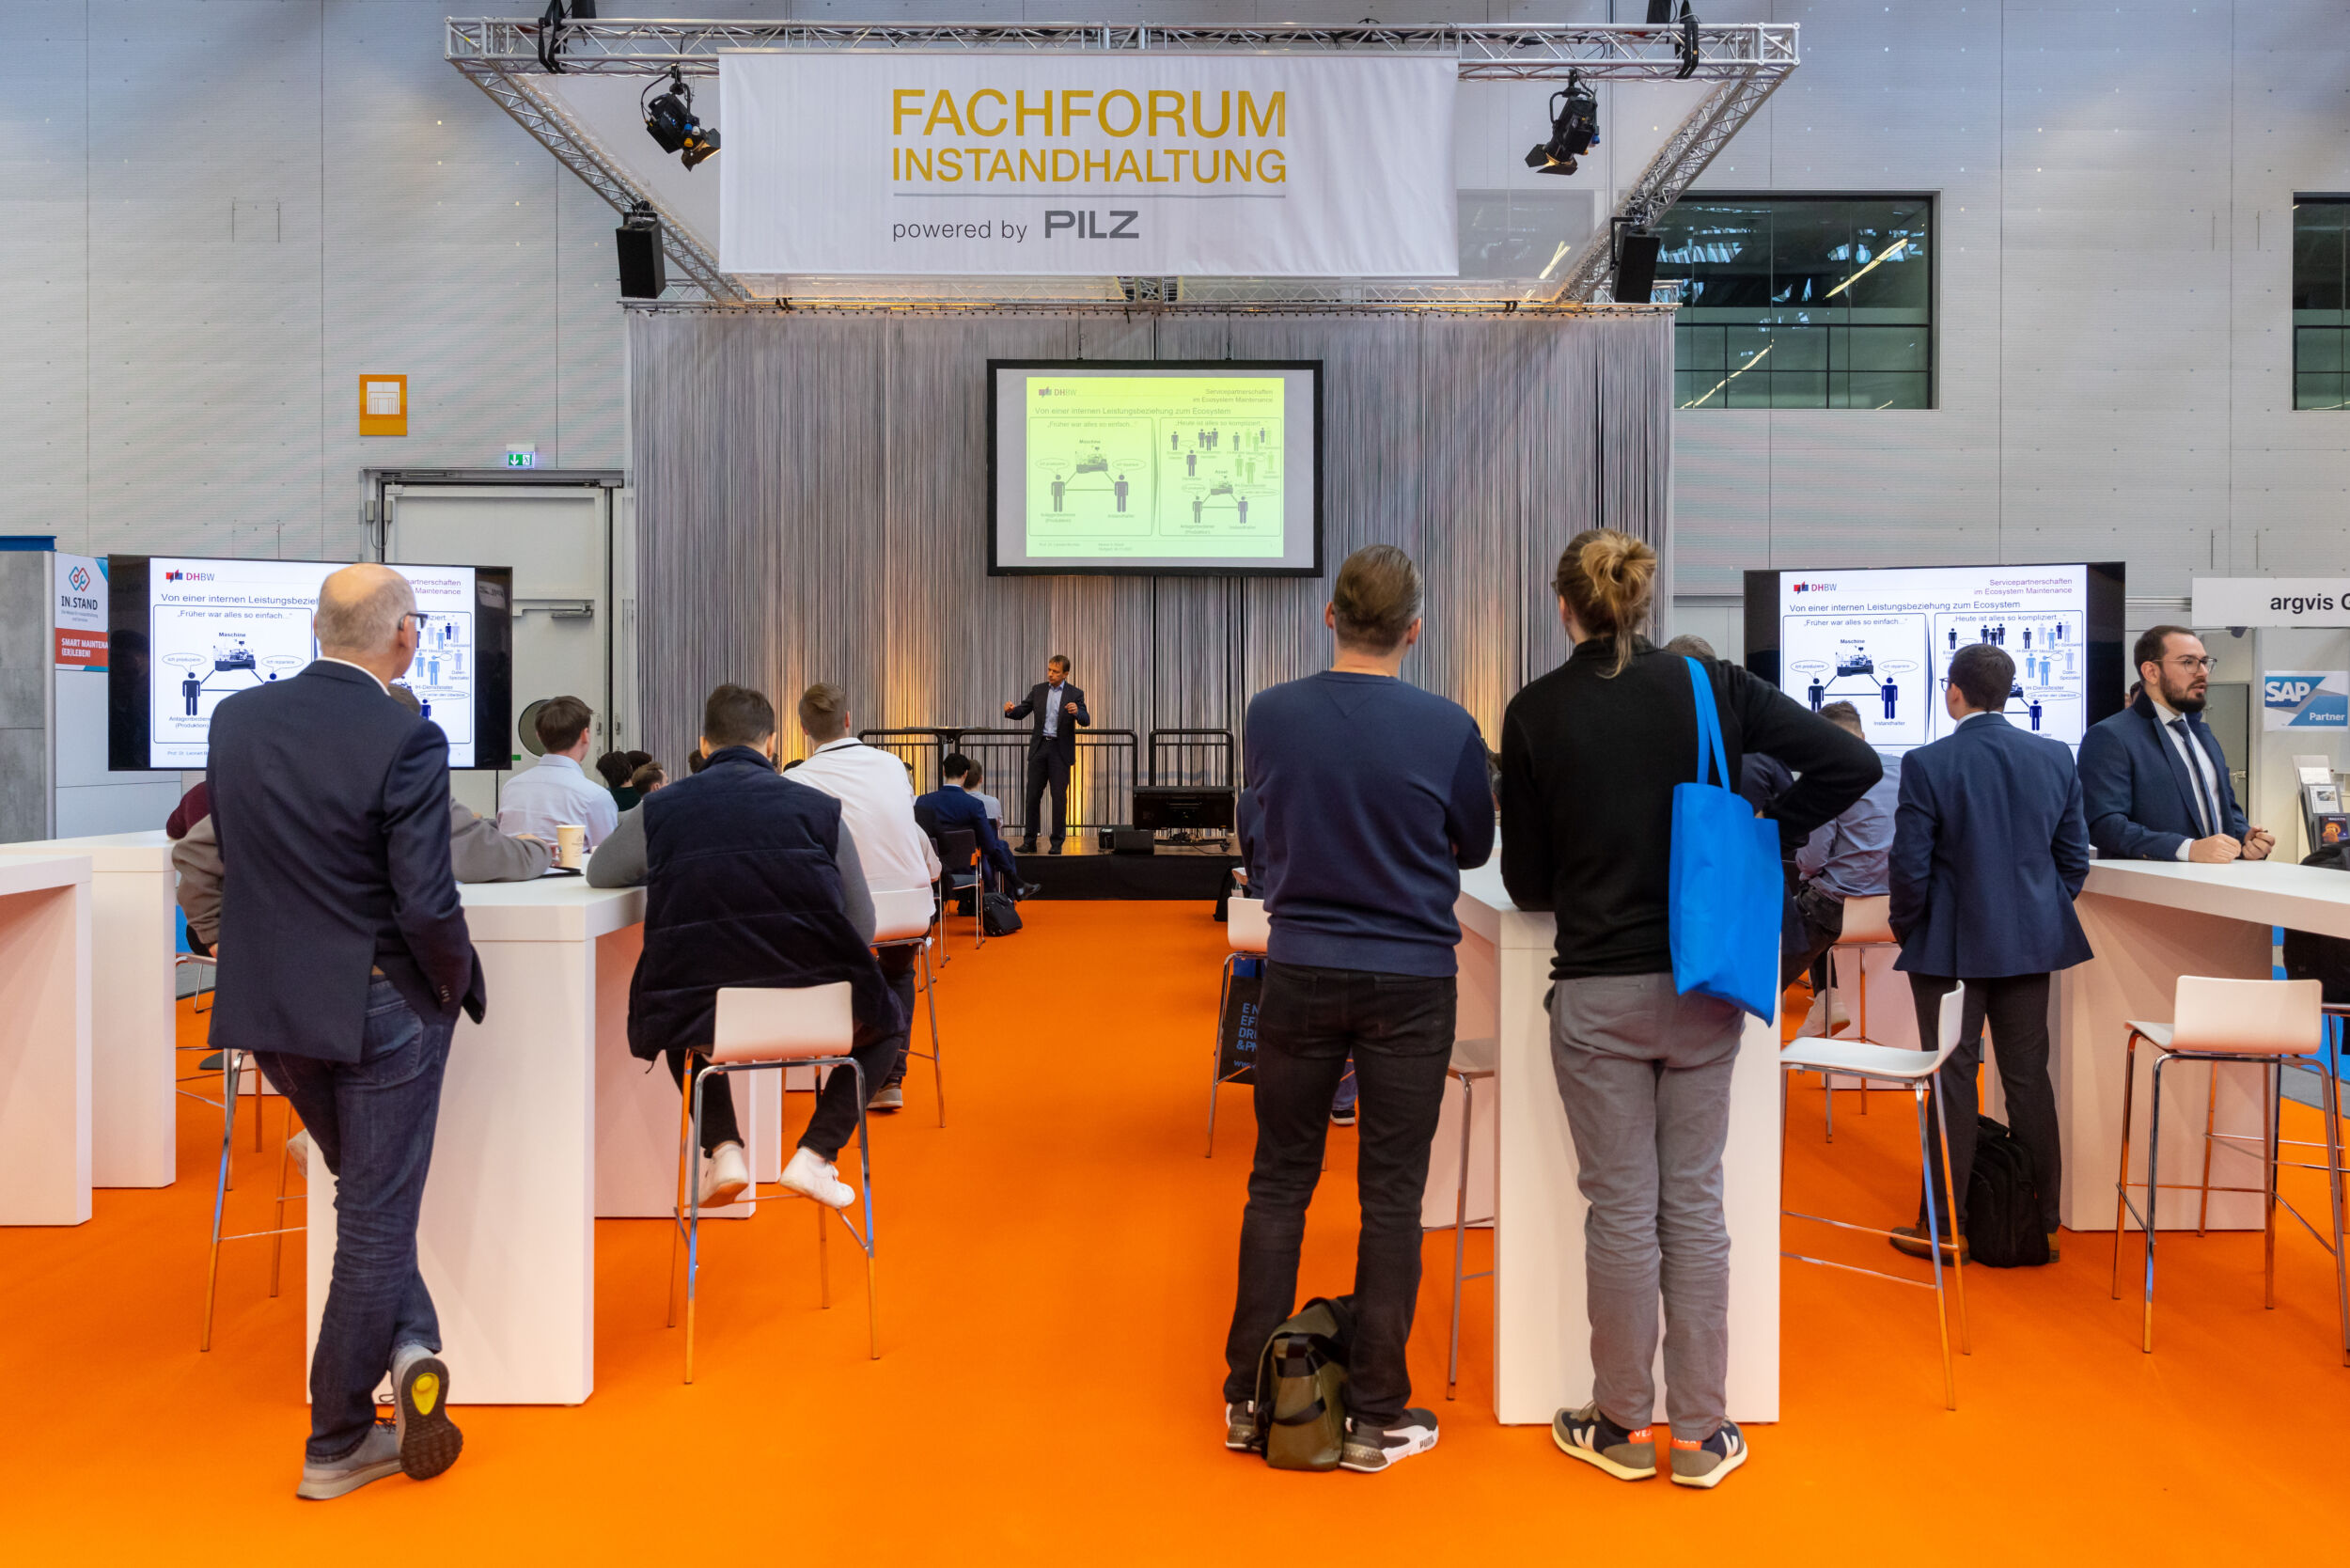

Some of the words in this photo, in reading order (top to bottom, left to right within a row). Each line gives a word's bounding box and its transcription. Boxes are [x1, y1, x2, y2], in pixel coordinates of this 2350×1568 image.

[892, 88, 1286, 138] FACHFORUM
[892, 148, 1287, 183] INSTANDHALTUNG
[892, 219, 993, 243] powered
[1001, 219, 1027, 243] by
[1044, 210, 1140, 239] PILZ
[1103, 408, 1173, 416] Leistungsbeziehung
[185, 572, 215, 581] DHBW
[1989, 578, 2073, 587] Servicepartnerschaften
[1984, 588, 2024, 597] Ecosystem
[61, 595, 99, 610] IN.STAND
[182, 594, 205, 603] einer
[209, 595, 246, 604] internen
[2270, 593, 2334, 615] argvis
[1867, 602, 1950, 612] Leistungsbeziehung
[1974, 602, 2021, 611] Ecosystem
[61, 637, 81, 647] SMART
[2265, 681, 2311, 702] SAP
[2310, 712, 2345, 721] Partner
